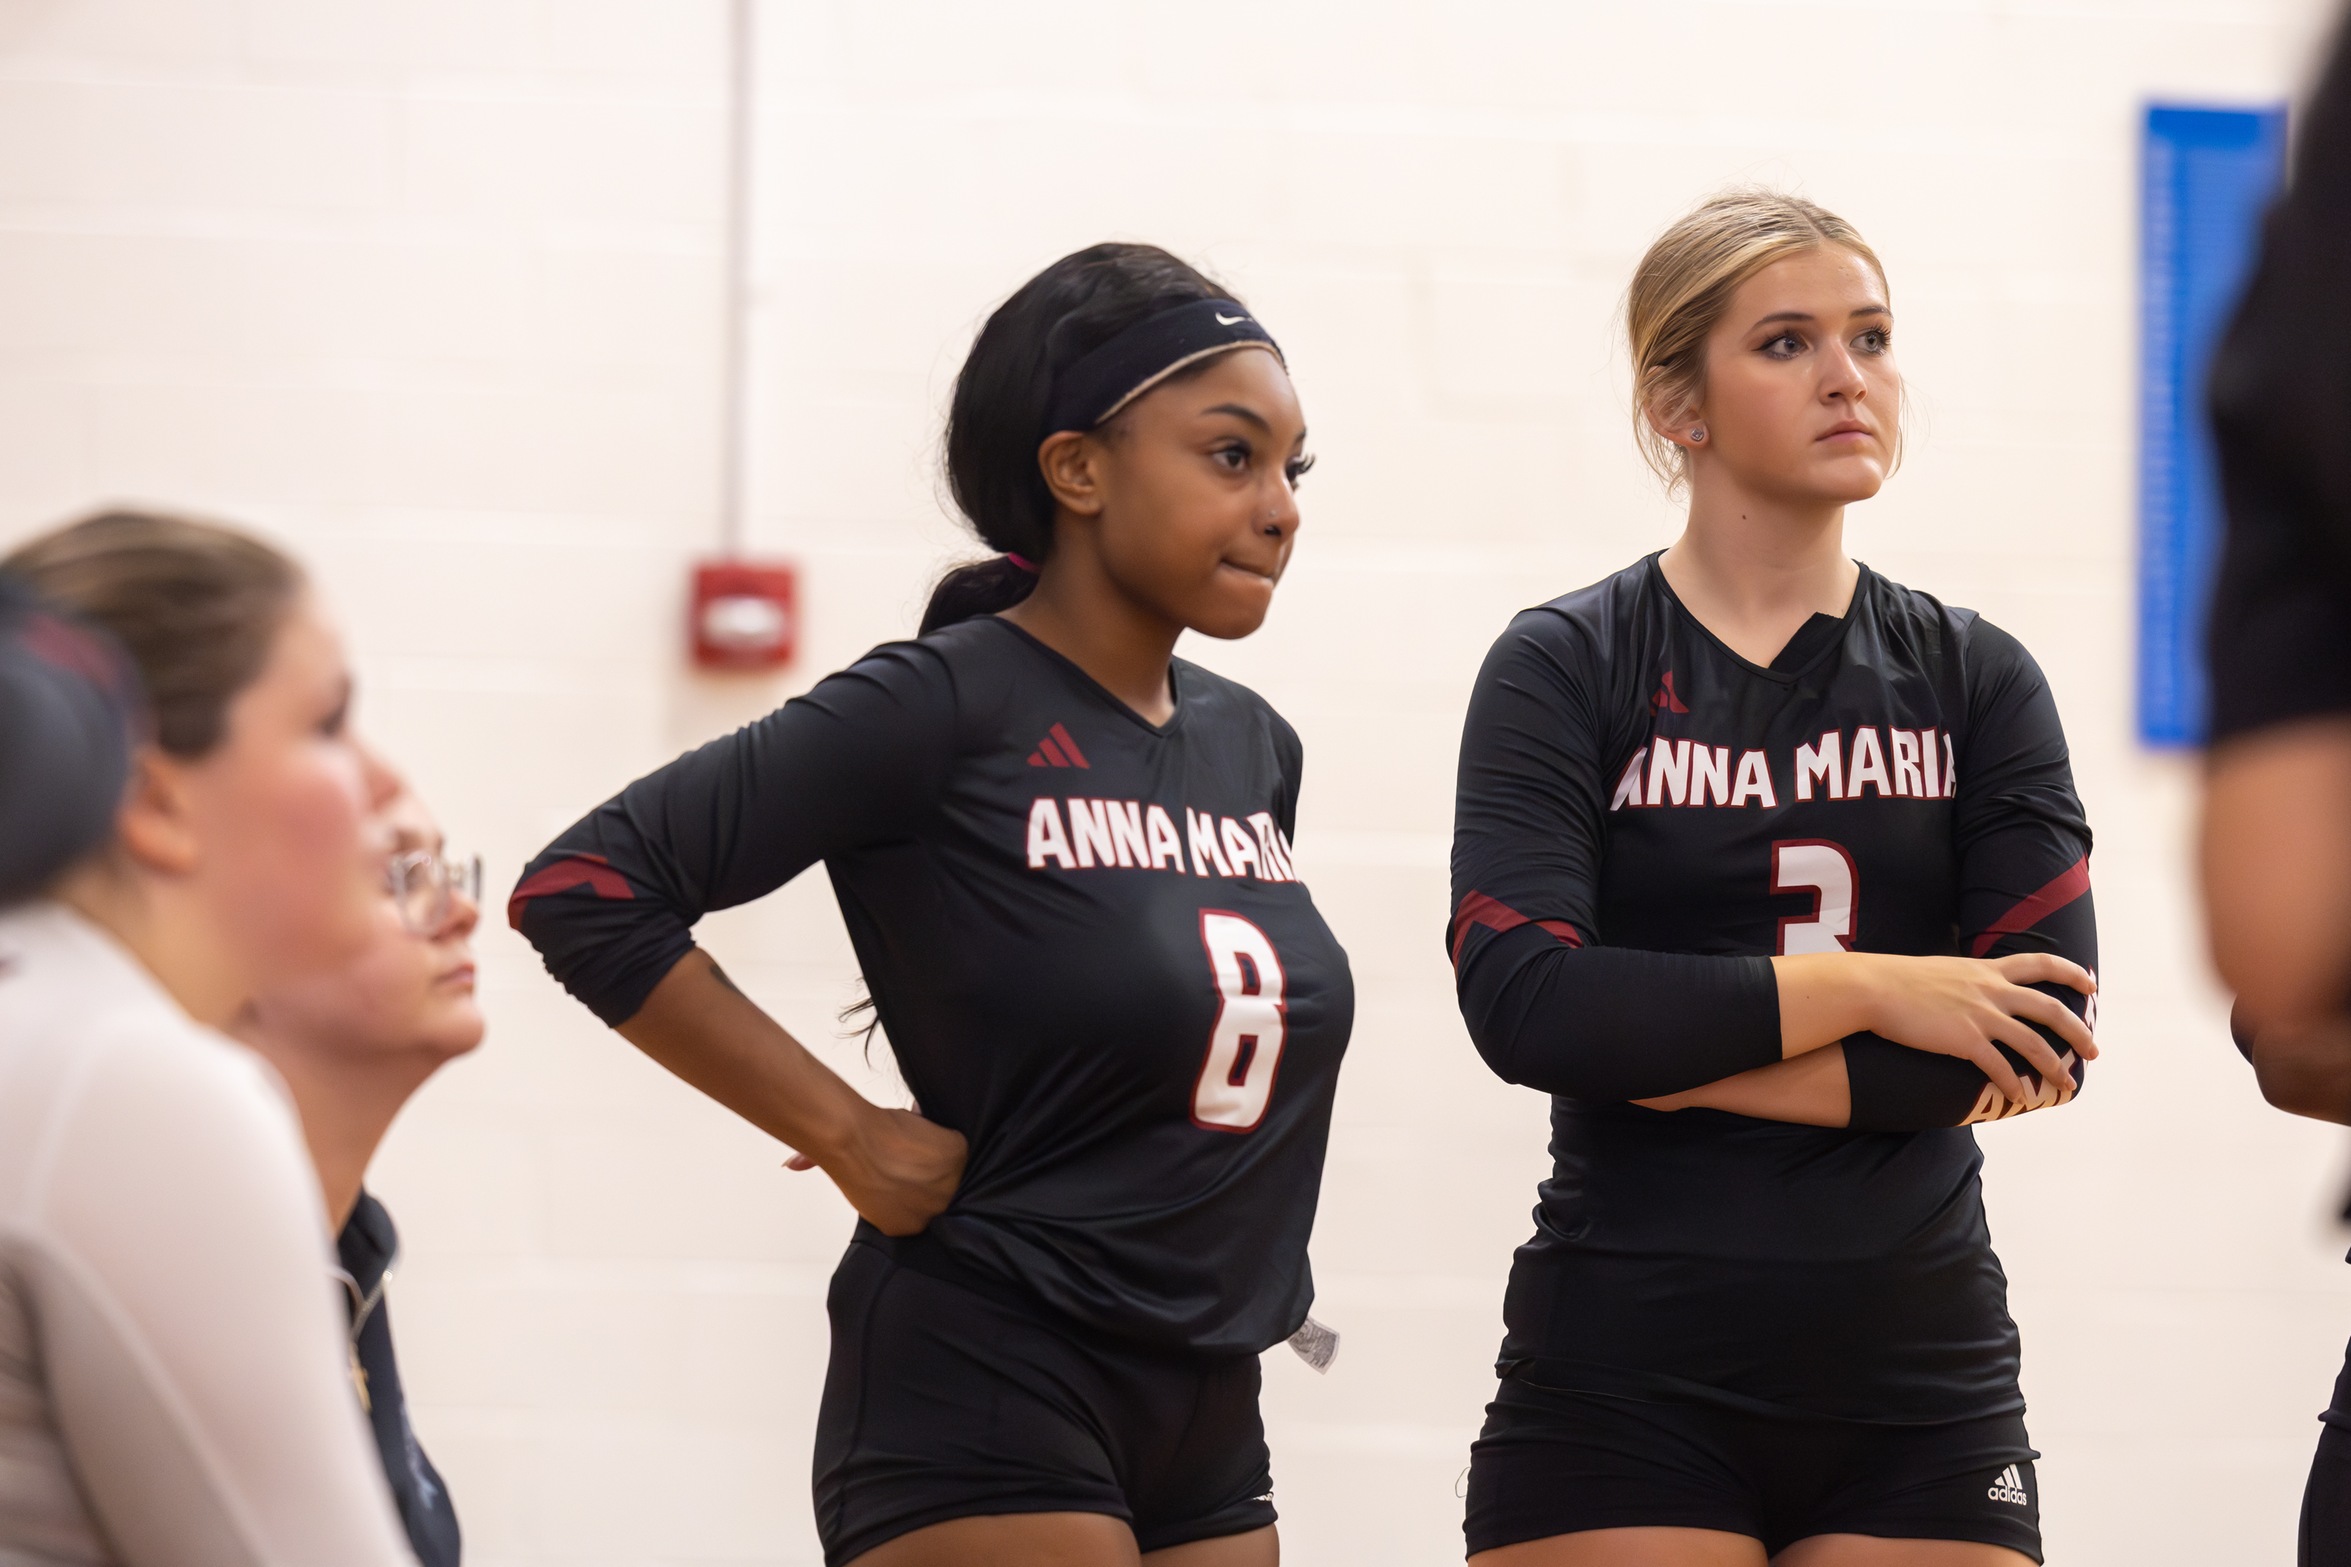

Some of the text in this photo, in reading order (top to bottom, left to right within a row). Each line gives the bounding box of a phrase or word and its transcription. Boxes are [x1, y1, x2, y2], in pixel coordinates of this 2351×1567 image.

[1027, 797, 1300, 884] ANNA MARI
[1189, 908, 1289, 1135] 8
[1987, 1485, 2027, 1506] adidas
